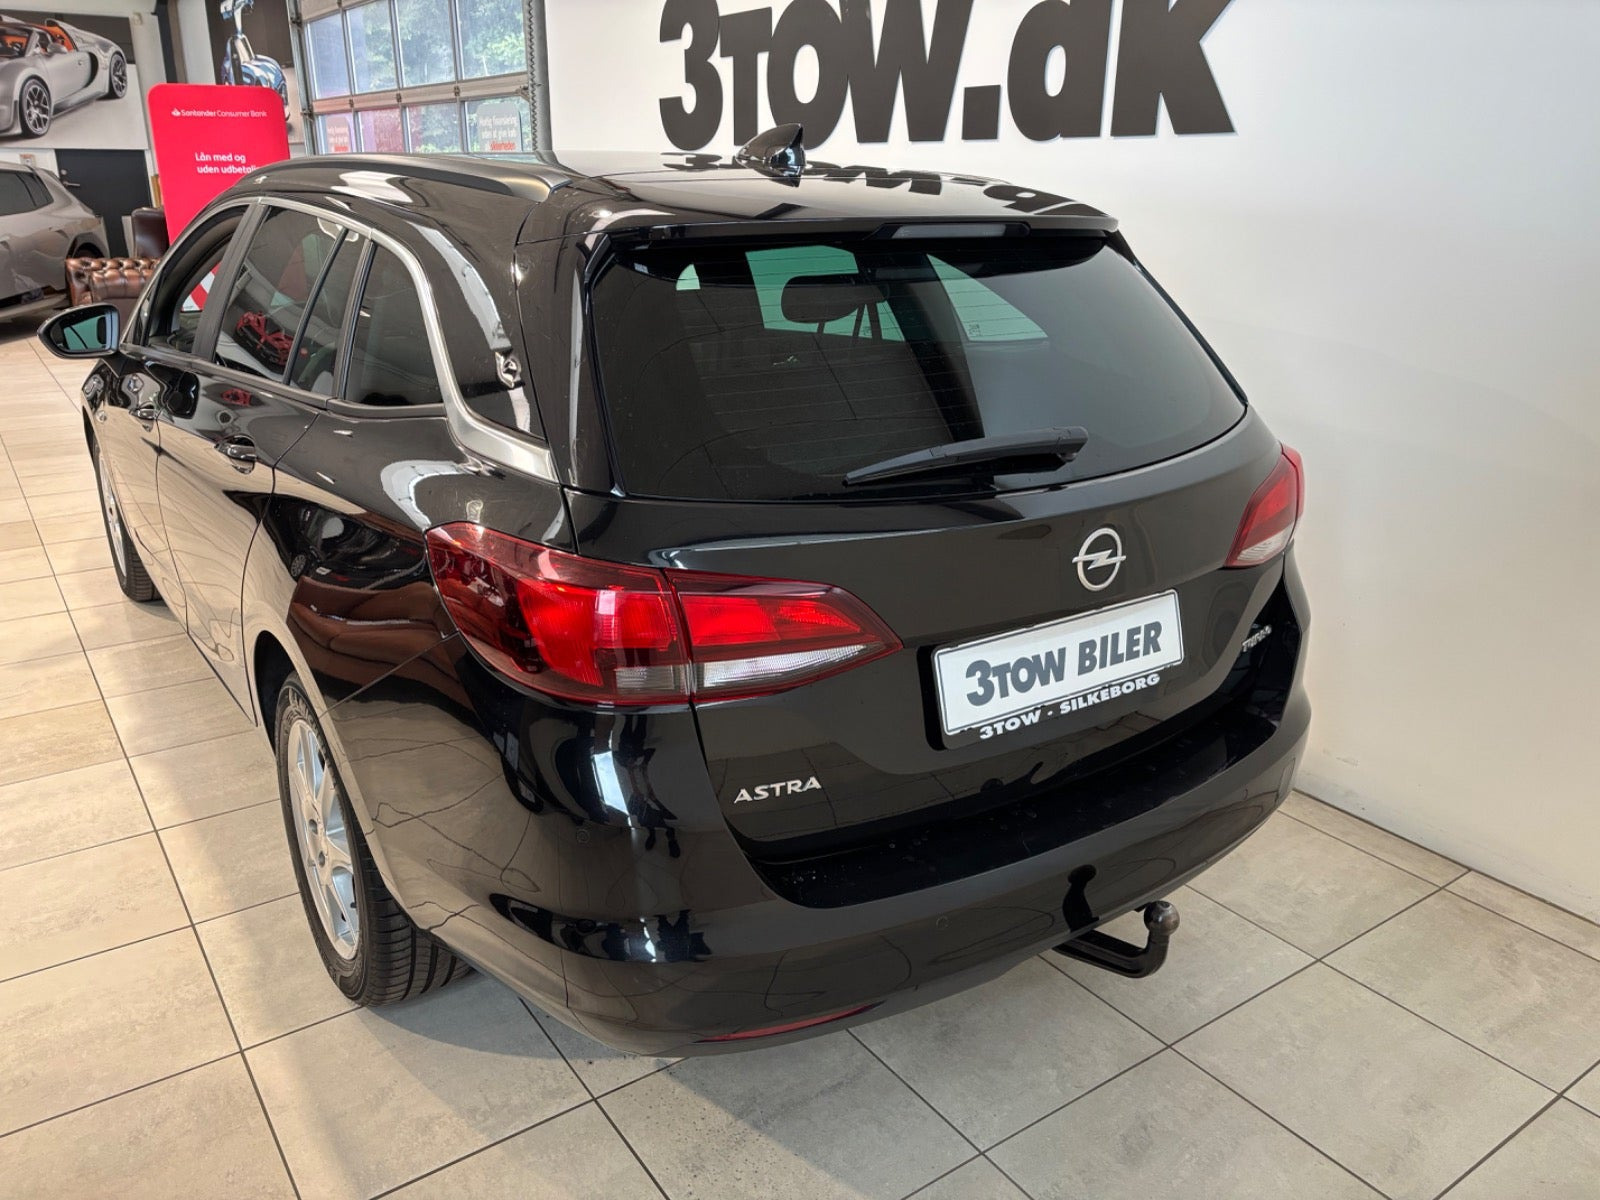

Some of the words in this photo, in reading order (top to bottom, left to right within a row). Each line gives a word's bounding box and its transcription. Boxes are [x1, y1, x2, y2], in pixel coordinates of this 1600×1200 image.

[180, 109, 216, 117] Santander
[194, 152, 212, 161] Lån
[213, 153, 233, 161] med
[234, 154, 246, 164] og
[197, 165, 219, 174] uden
[221, 165, 258, 174] udbetali
[965, 646, 1067, 707] 3TOW
[1077, 620, 1163, 676] BILER
[979, 708, 1042, 740] 3TOW
[1059, 673, 1161, 715] SILKEBORG
[733, 776, 822, 804] ASTRA
